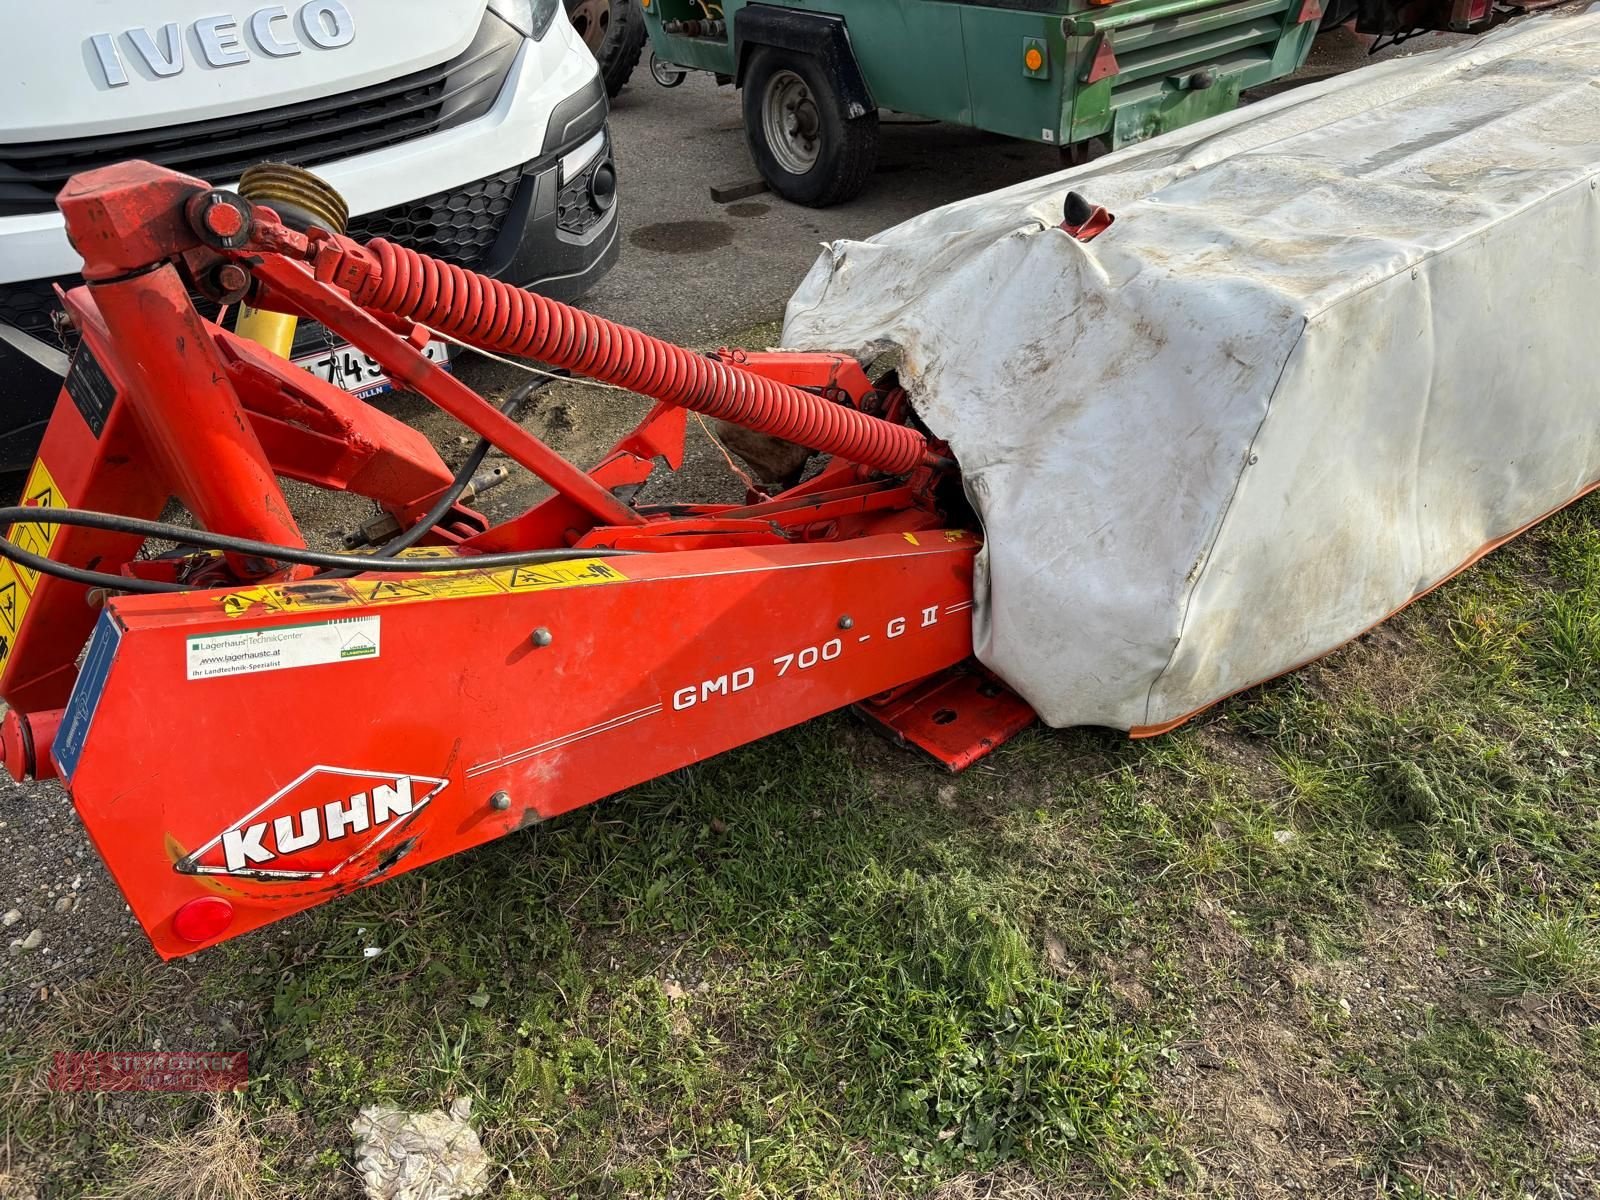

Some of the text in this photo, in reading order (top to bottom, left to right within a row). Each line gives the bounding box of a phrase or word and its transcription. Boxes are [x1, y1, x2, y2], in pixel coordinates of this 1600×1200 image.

[91, 0, 355, 88] IVECO
[355, 386, 383, 399] ULLN
[204, 660, 280, 675] Landtechnik-Spezialist
[673, 666, 754, 710] GMD
[773, 638, 842, 677] 700
[886, 616, 905, 639] G
[221, 775, 413, 872] KUHN
